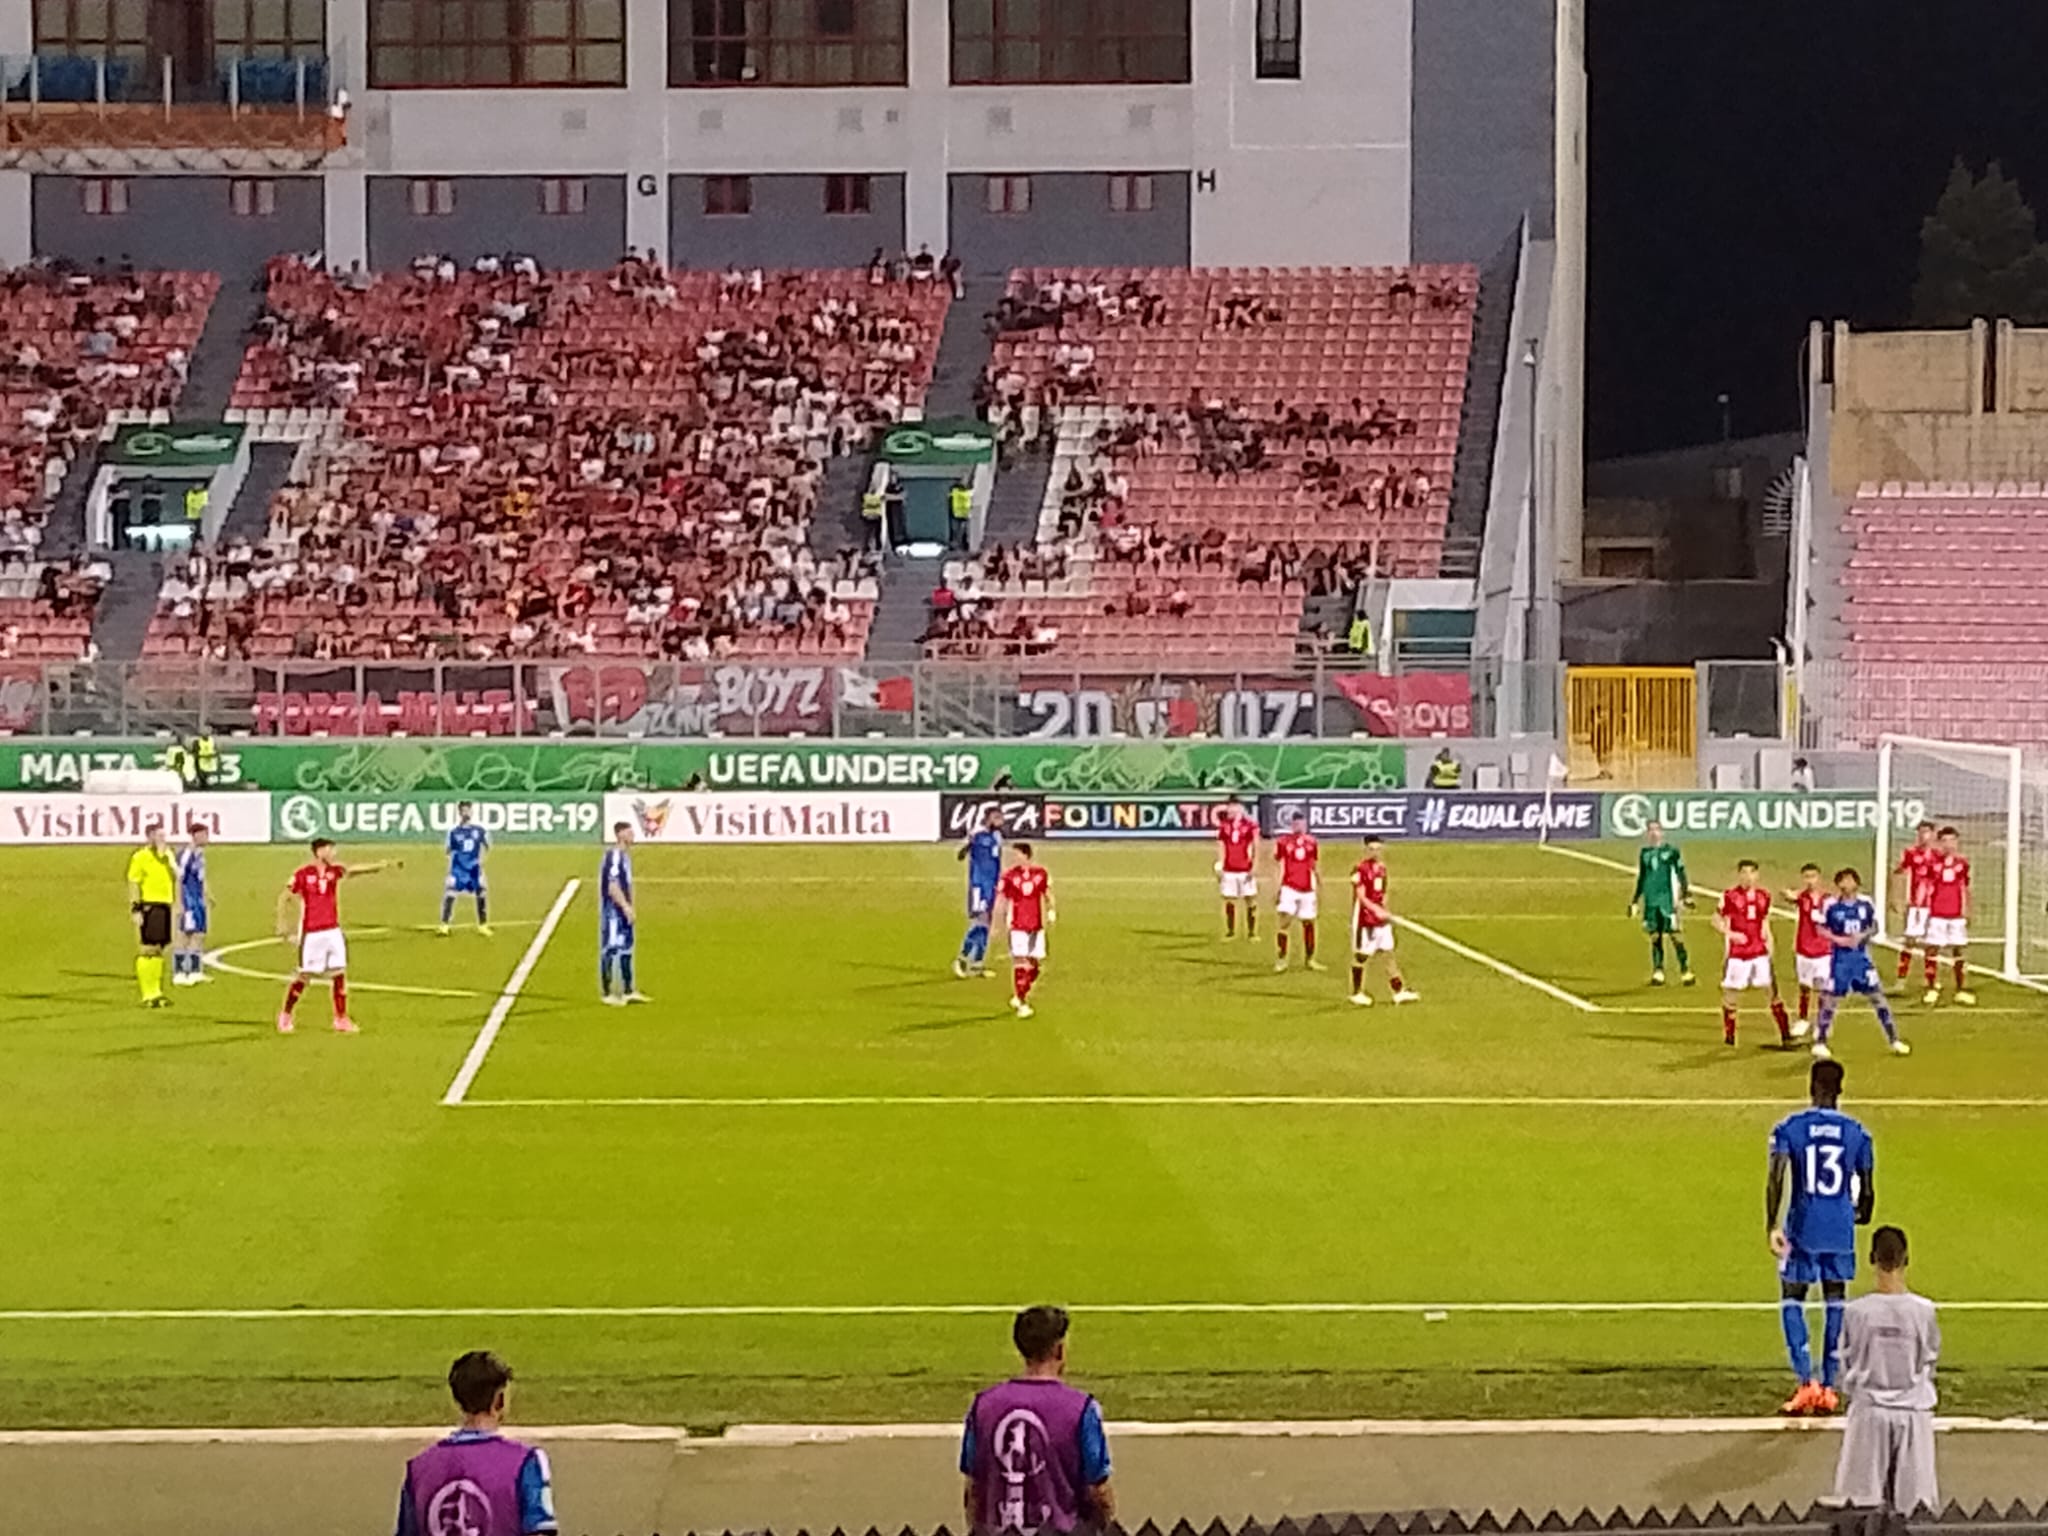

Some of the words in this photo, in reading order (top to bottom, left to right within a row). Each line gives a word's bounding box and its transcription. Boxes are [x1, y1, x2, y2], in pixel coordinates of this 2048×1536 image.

[637, 174, 657, 197] G
[1197, 168, 1216, 193] H
[708, 754, 805, 784] UEFA
[810, 754, 980, 784] UNDER-19
[328, 802, 425, 832] UEFA
[950, 801, 1040, 831] UEFA
[1309, 805, 1407, 827] RESPECT
[1658, 800, 1752, 830] UEFA
[1805, 1144, 1845, 1196] 13
